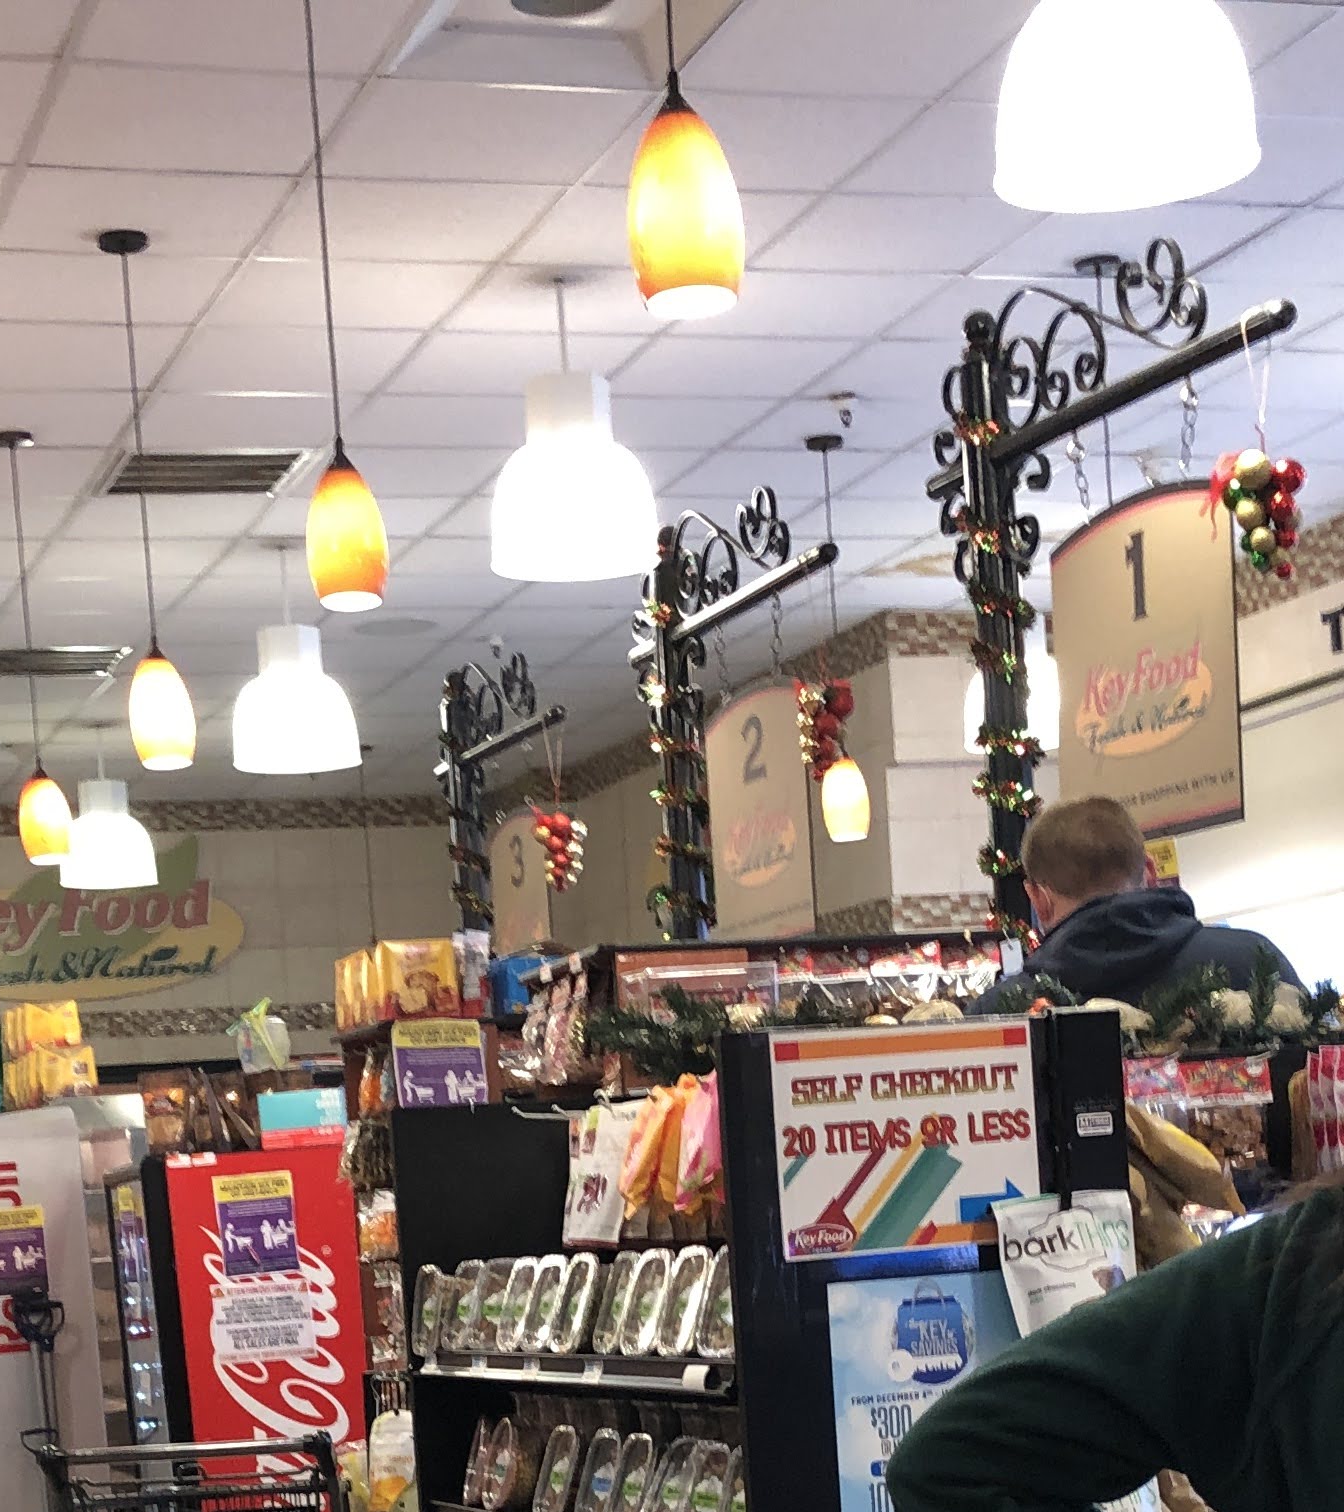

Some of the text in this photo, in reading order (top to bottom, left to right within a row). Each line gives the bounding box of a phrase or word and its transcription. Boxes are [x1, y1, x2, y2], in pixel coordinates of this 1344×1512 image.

[1123, 530, 1148, 621] 1
[741, 713, 768, 785] 2
[508, 833, 525, 887] 3
[58, 877, 214, 939] Food
[790, 1061, 1019, 1107] SELF CHECKOUT
[782, 1107, 1032, 1159] 20 ITEMS OR LESS
[910, 1337, 959, 1357] SAVINGS
[918, 1319, 948, 1343] KEY
[851, 1395, 874, 1406] FROM
[876, 1391, 920, 1404] DECEMBER
[870, 1404, 913, 1440] $300
